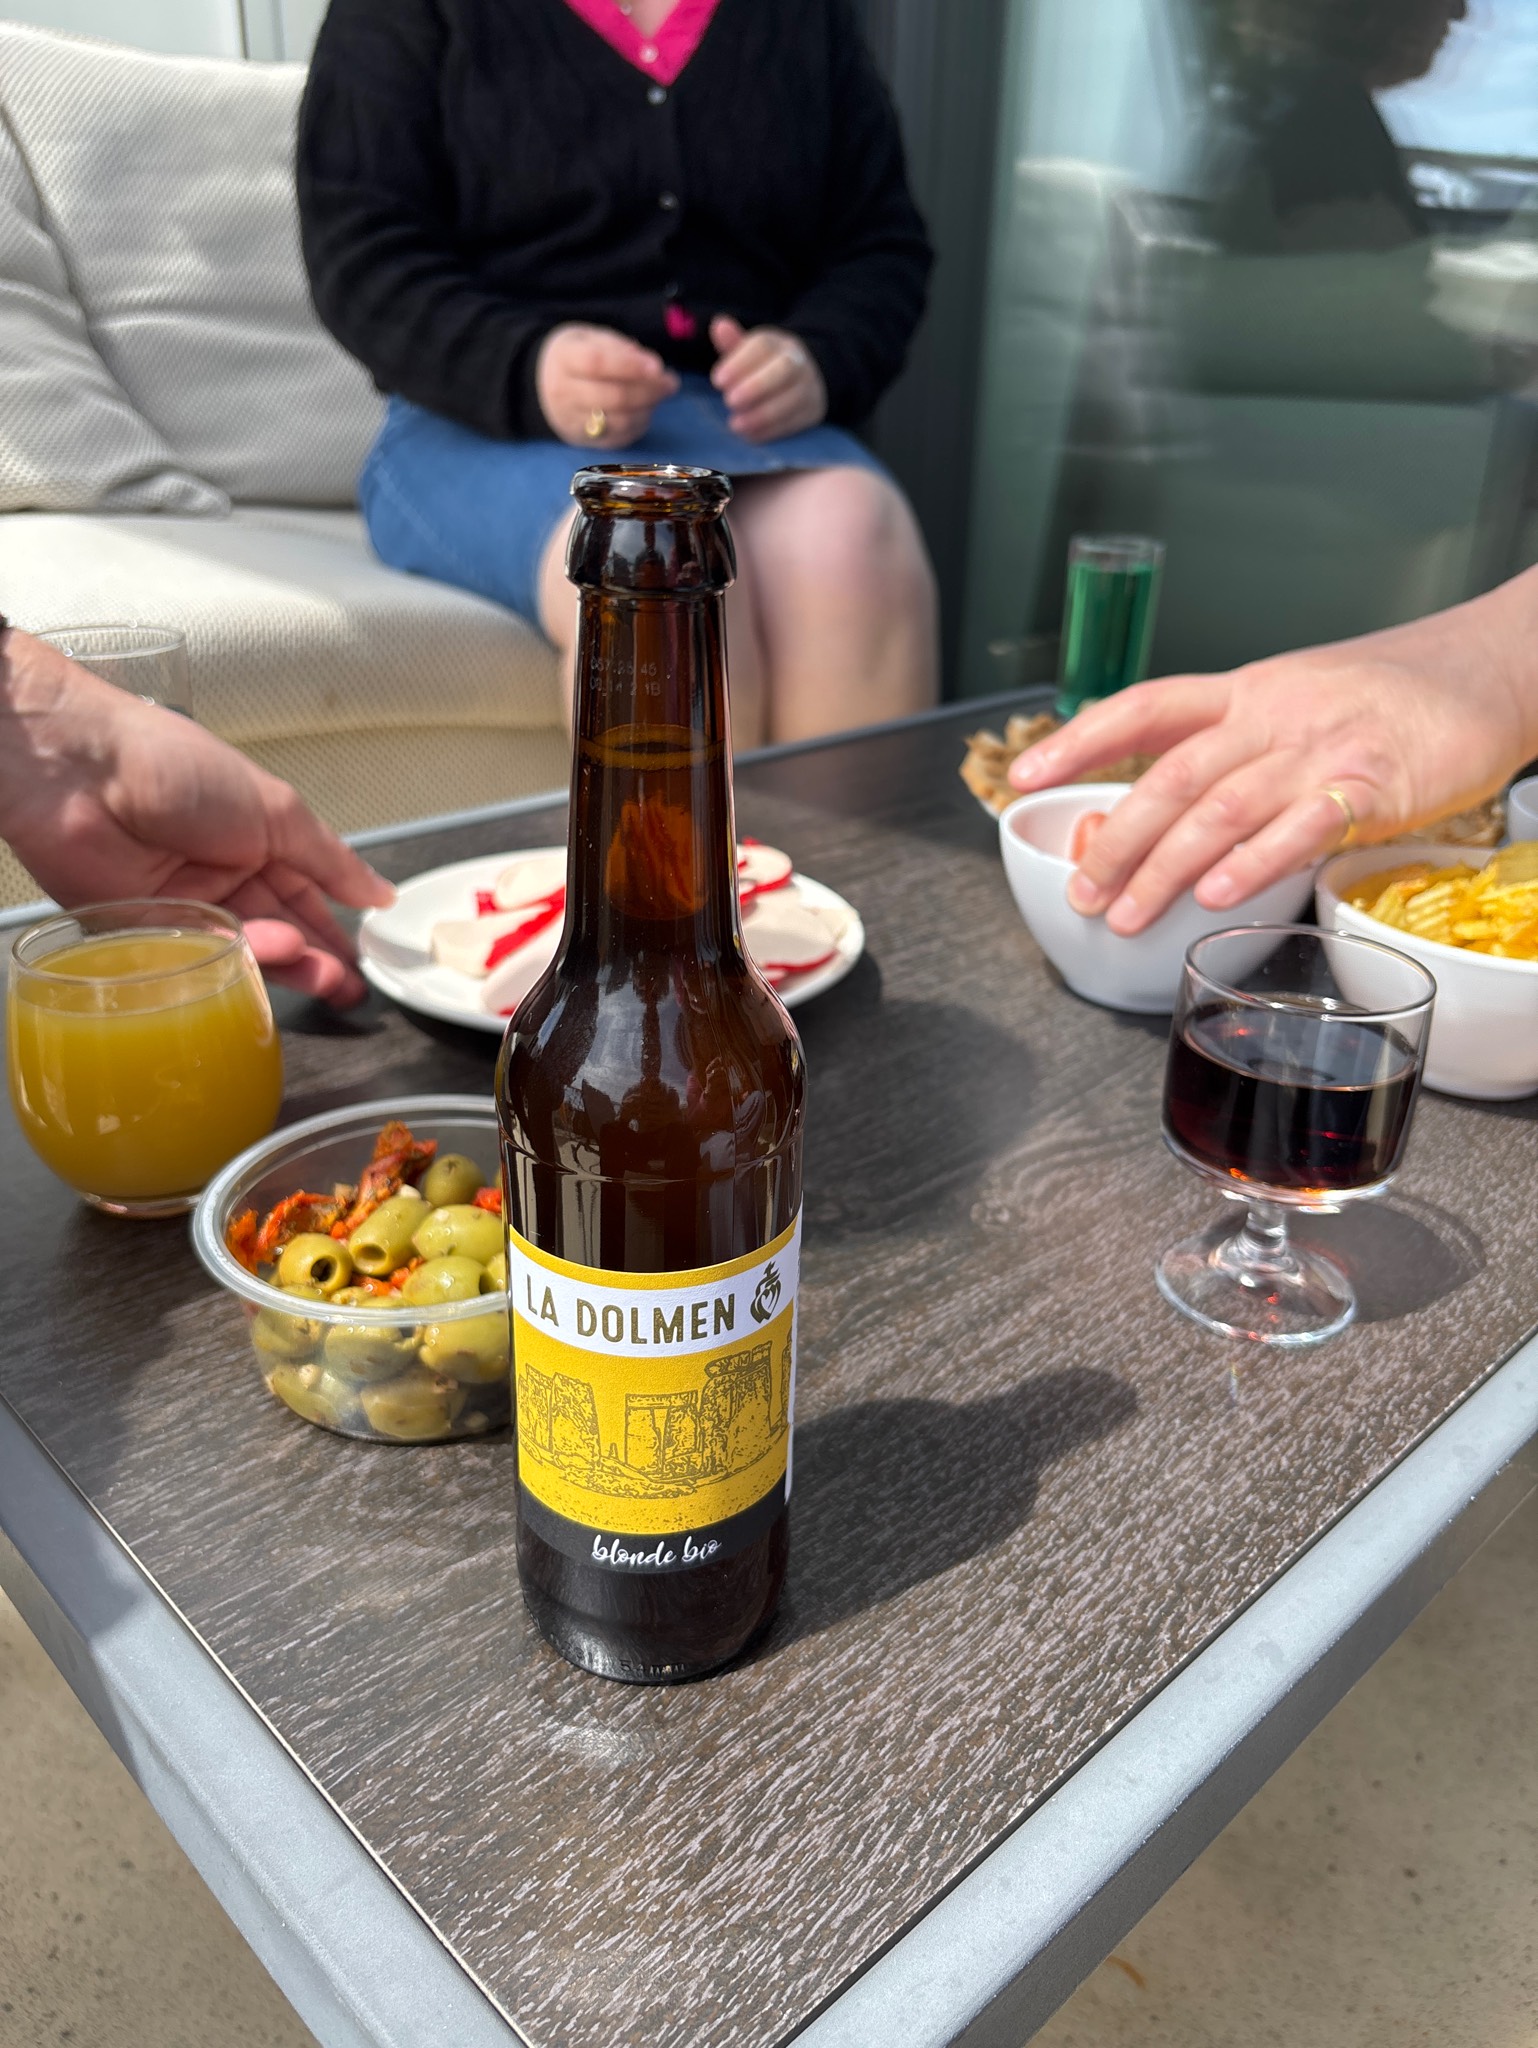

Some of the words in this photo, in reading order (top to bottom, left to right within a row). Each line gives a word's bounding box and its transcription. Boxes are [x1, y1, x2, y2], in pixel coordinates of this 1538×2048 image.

[526, 1273, 559, 1328] LA
[576, 1292, 736, 1345] DOLMEN
[591, 1534, 677, 1566] blonde
[681, 1535, 722, 1562] bio
